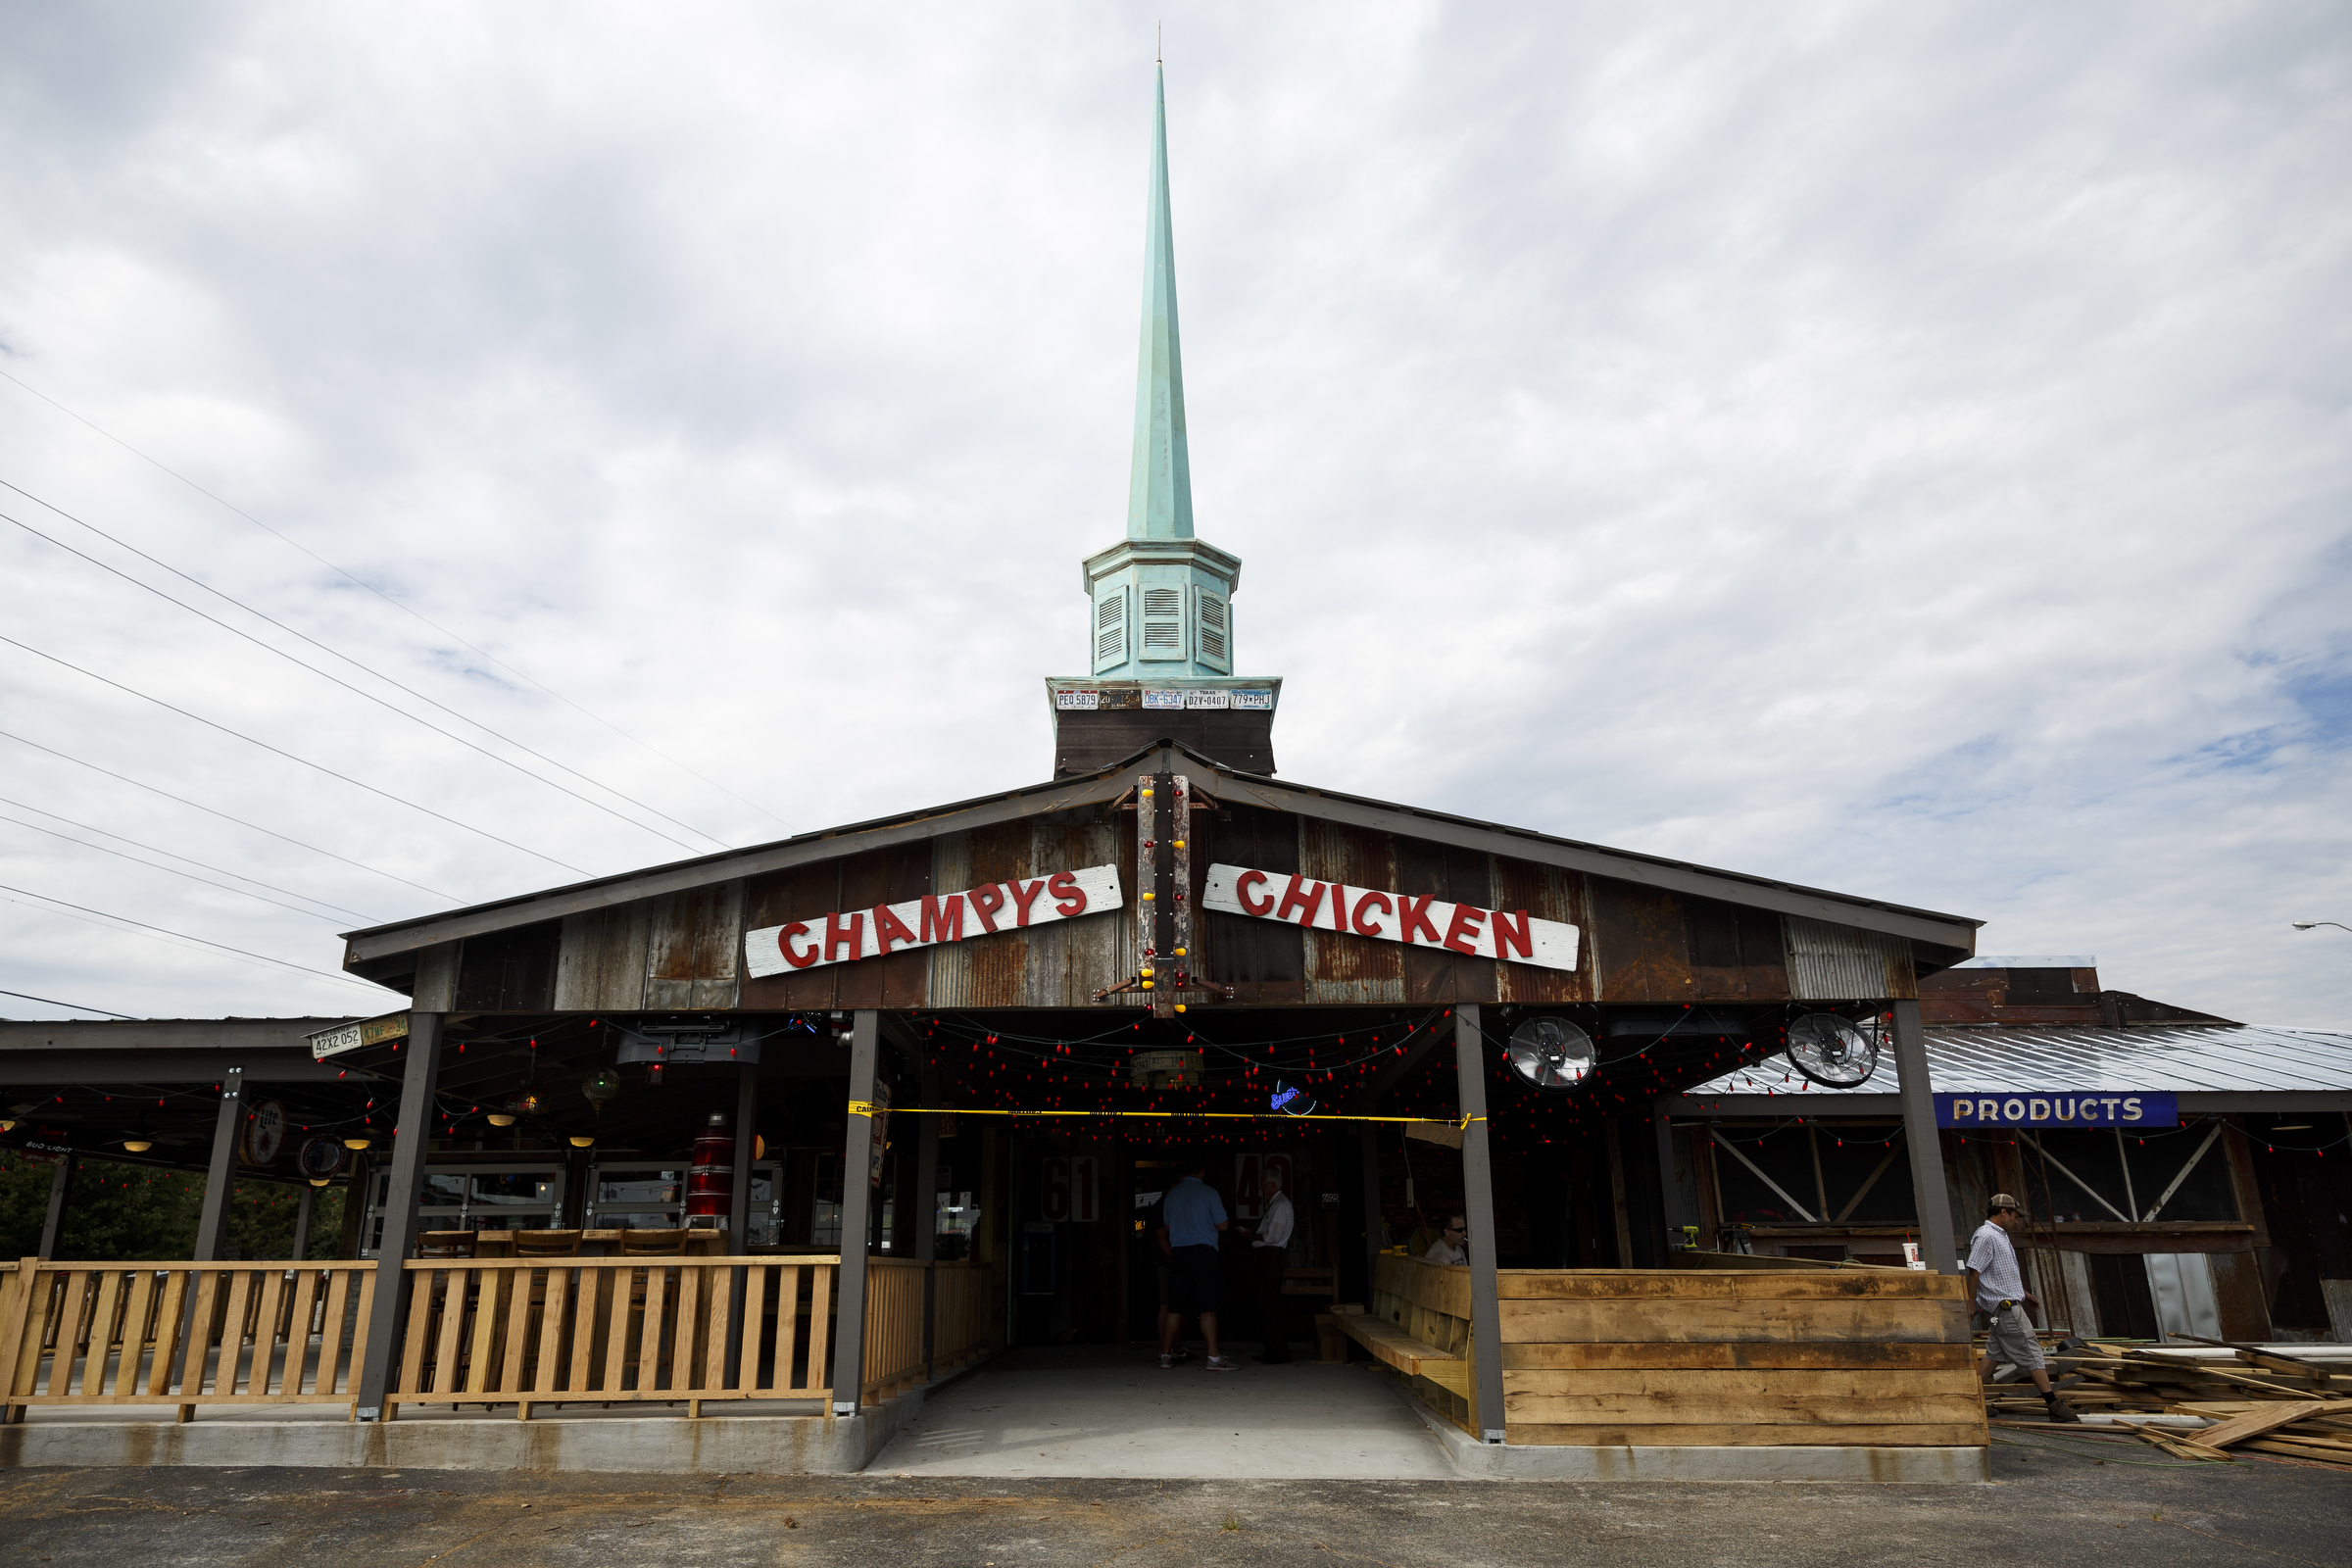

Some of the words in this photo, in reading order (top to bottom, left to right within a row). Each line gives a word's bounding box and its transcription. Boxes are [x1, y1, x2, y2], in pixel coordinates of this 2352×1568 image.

[1076, 695, 1096, 705] 5879
[1233, 694, 1248, 705] 779
[1253, 694, 1270, 705] PHJ
[778, 870, 1087, 968] CHAMPYS
[1236, 869, 1533, 958] CHICKEN
[316, 1035, 339, 1052] 42X2
[341, 1029, 359, 1045] 052
[260, 1108, 278, 1130] Lite
[1952, 1097, 2143, 1121] PRODUCTS
[25, 1141, 45, 1150] BUD
[46, 1145, 74, 1153] LIGHT
[1042, 1157, 1093, 1220] 61
